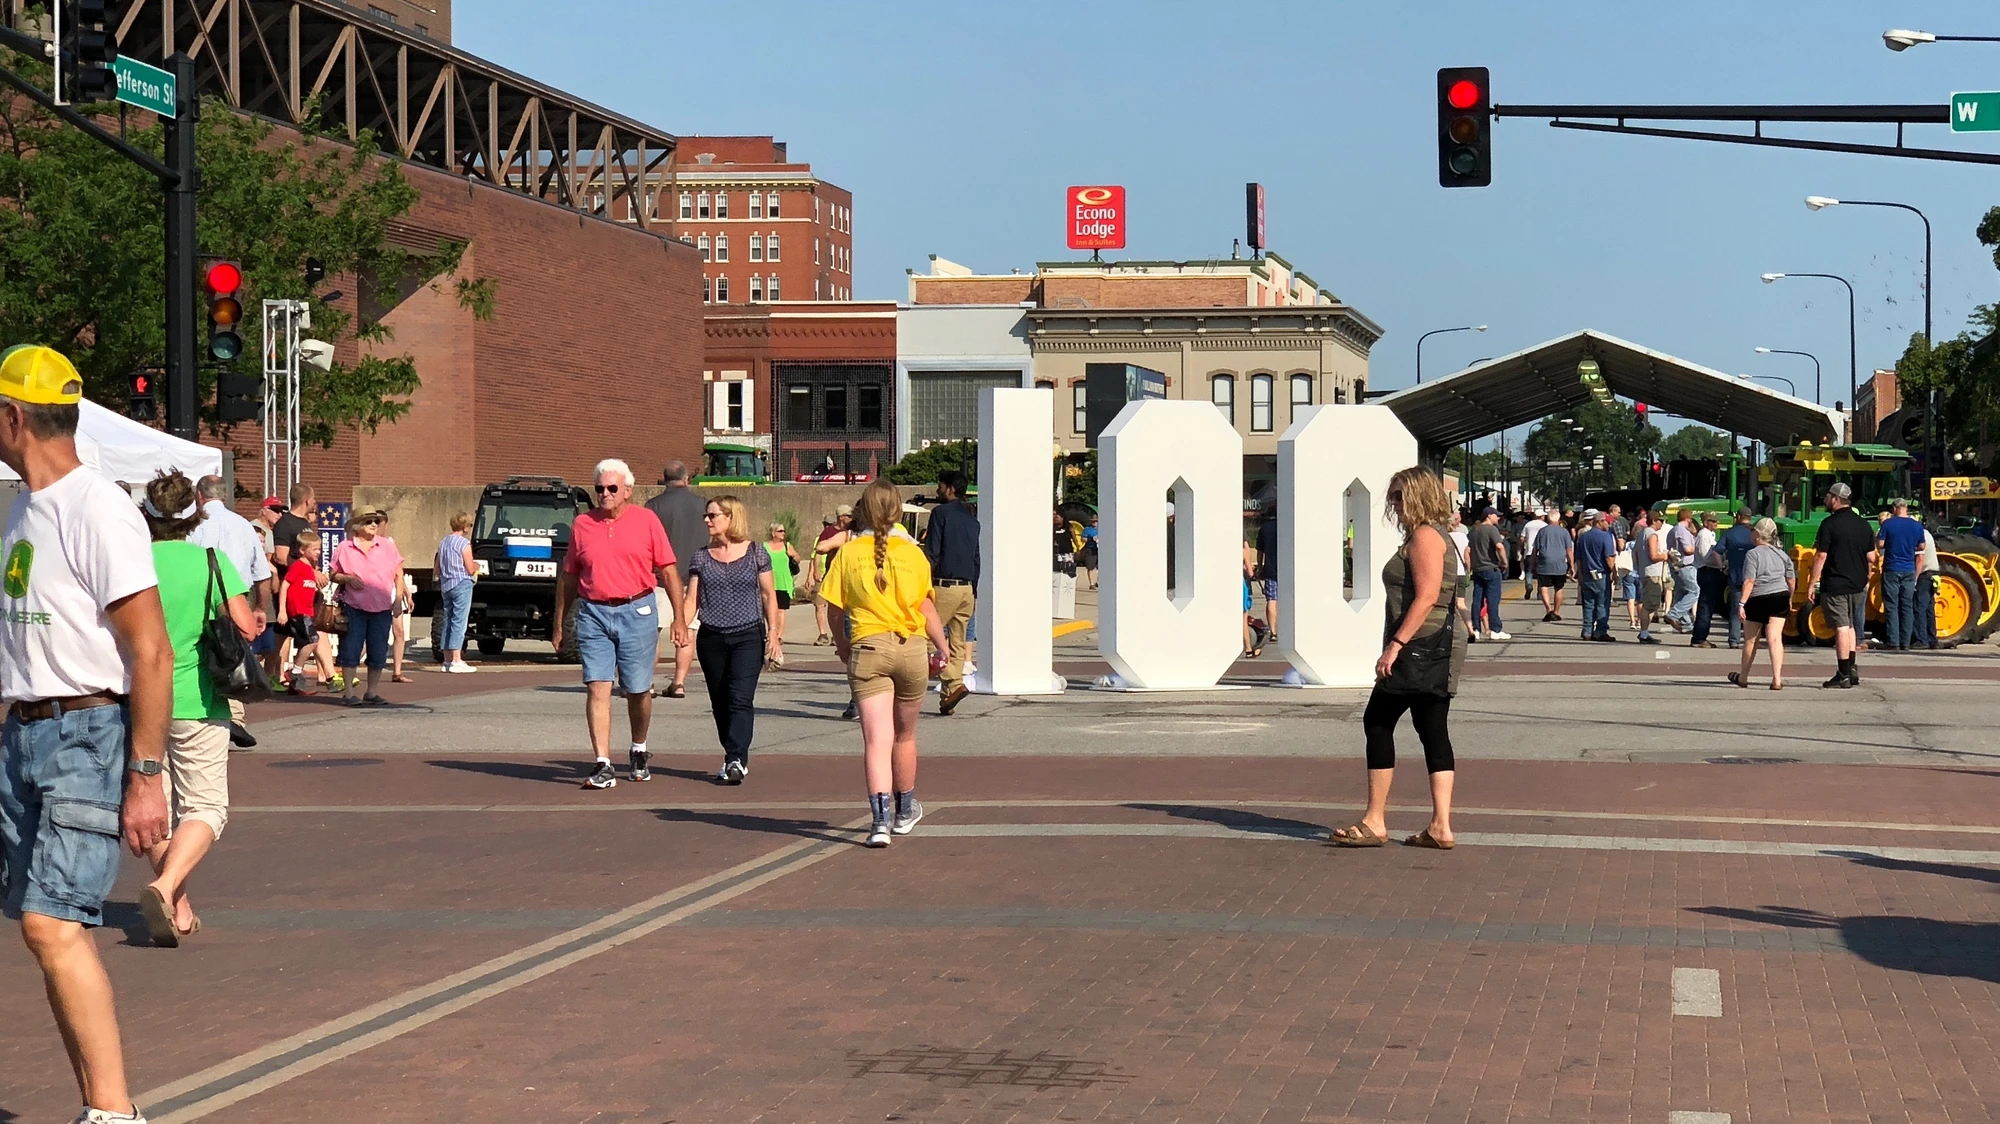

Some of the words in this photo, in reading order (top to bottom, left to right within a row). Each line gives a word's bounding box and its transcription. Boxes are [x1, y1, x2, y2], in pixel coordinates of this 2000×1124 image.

[113, 66, 159, 101] efferson
[163, 83, 174, 106] St
[1957, 102, 1978, 122] W
[1076, 205, 1116, 220] Econo
[1076, 220, 1116, 239] Lodge
[1934, 480, 1982, 488] COLD
[497, 527, 558, 536] POLICE
[527, 563, 546, 573] 911
